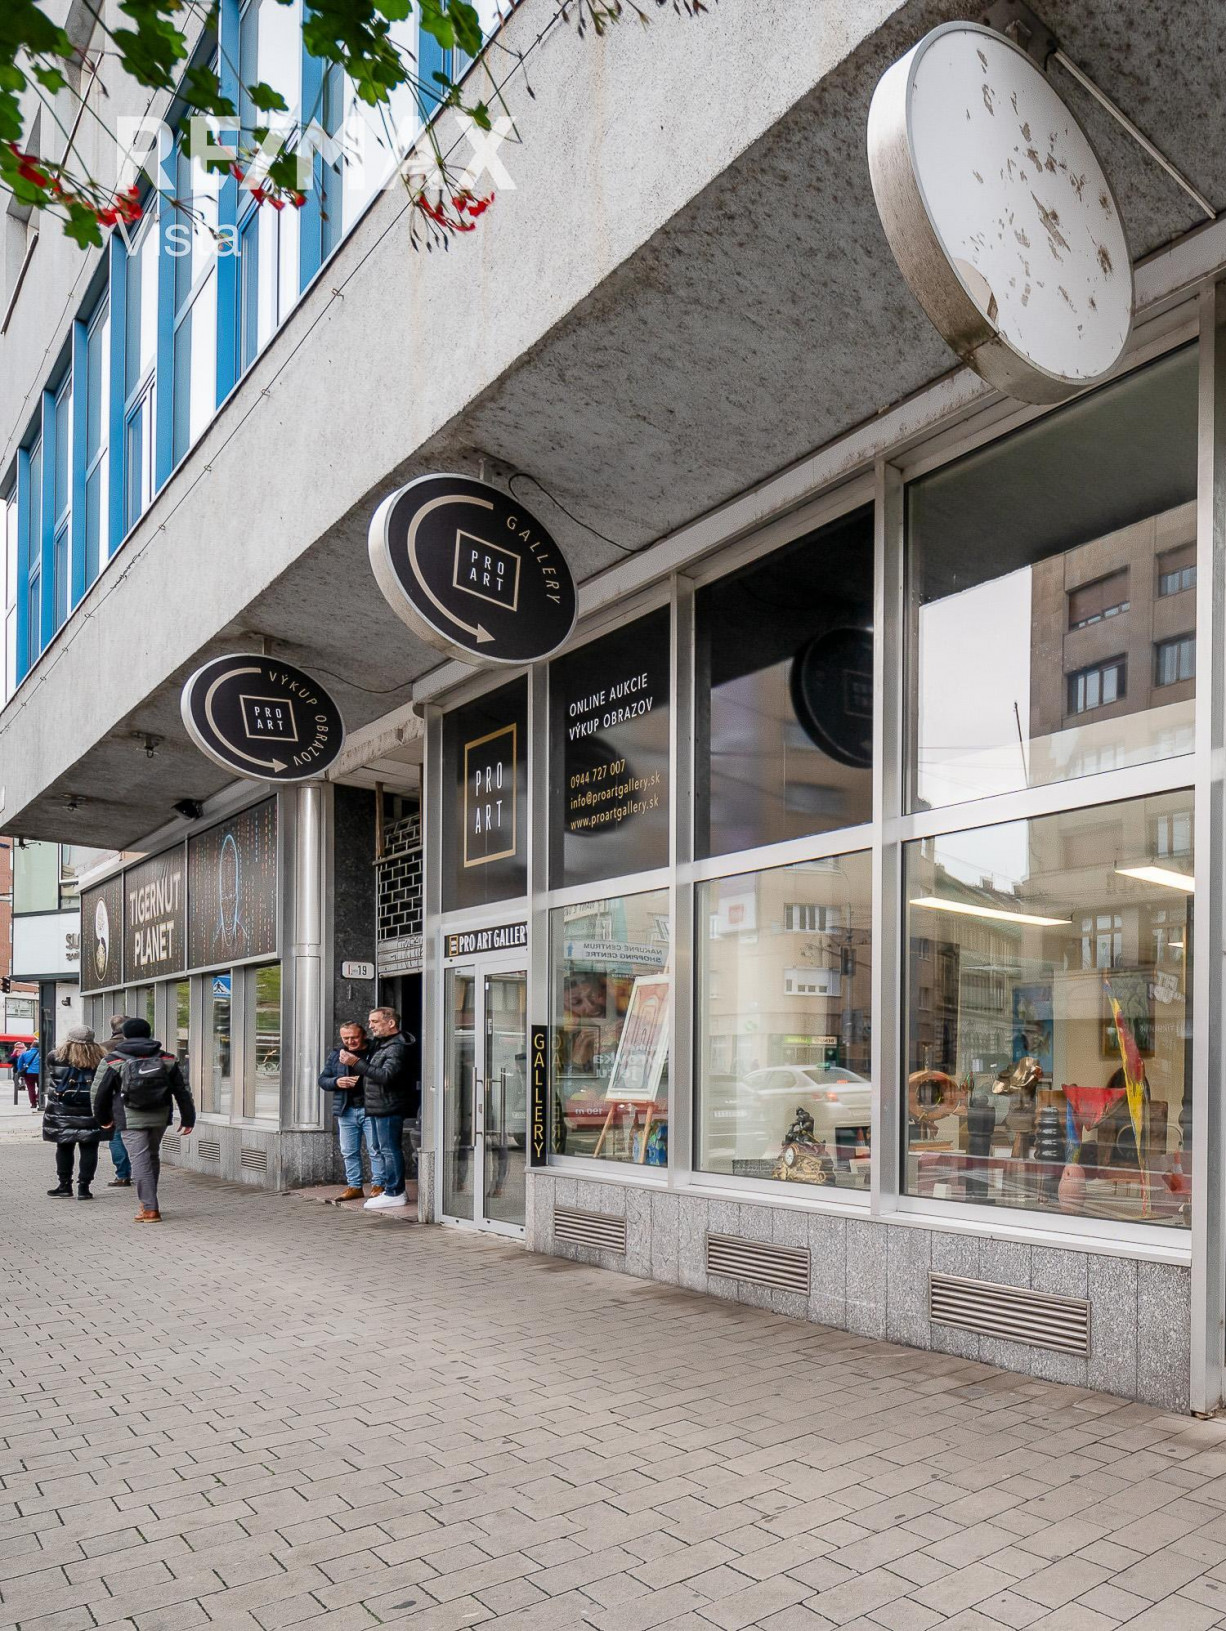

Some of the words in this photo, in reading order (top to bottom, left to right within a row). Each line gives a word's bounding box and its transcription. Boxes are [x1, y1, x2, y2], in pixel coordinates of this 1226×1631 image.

[471, 550, 504, 575] PRO
[506, 516, 560, 604] GALLERY
[469, 567, 504, 591] ART
[269, 671, 318, 706] VÝKUP
[569, 690, 606, 717] ONLINE
[609, 673, 648, 701] AUKCIE
[254, 706, 282, 719] PRO
[257, 719, 283, 731] ART
[569, 718, 600, 741] VÝKUP
[603, 697, 653, 728] OBRAZOV
[293, 714, 329, 767] OBRAZOV
[475, 762, 502, 796] PRO
[570, 771, 590, 789] 0944
[592, 765, 607, 782] 727
[610, 759, 625, 775] 007
[570, 770, 661, 810] info@proartgallery.sk
[475, 800, 502, 834] ART
[570, 793, 659, 830] www.proartgallery.sk
[130, 871, 181, 926] TIGERNUT
[134, 920, 174, 967] PLANET
[459, 934, 476, 952] PRO
[477, 931, 493, 950] ART
[534, 1034, 544, 1157] GALLERY
